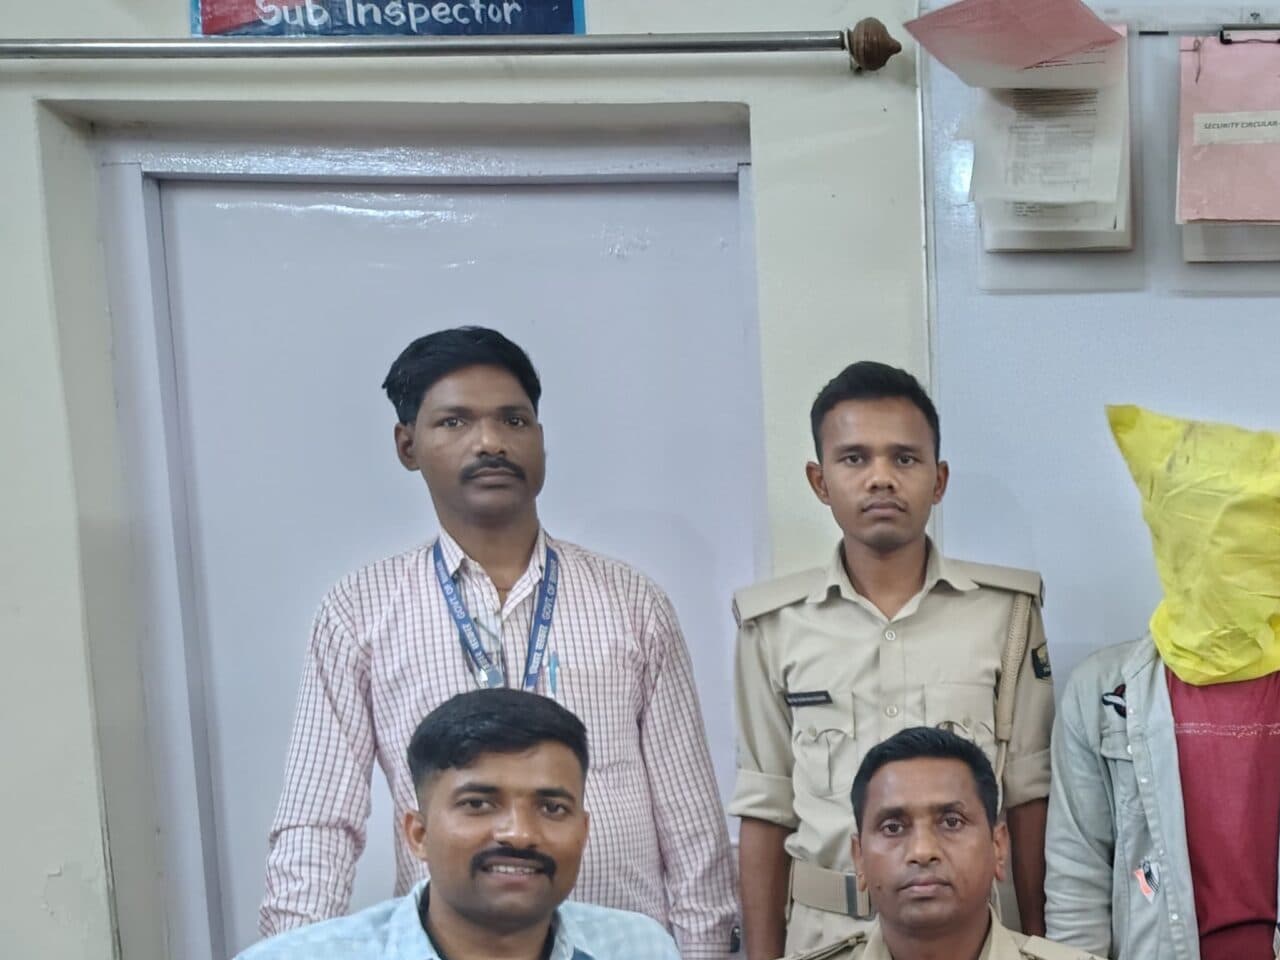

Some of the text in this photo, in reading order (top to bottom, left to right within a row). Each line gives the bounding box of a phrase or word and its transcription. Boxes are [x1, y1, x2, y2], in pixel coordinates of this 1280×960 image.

[259, 0, 522, 32] Sub Inspector
[1203, 122, 1240, 130] SECURITY
